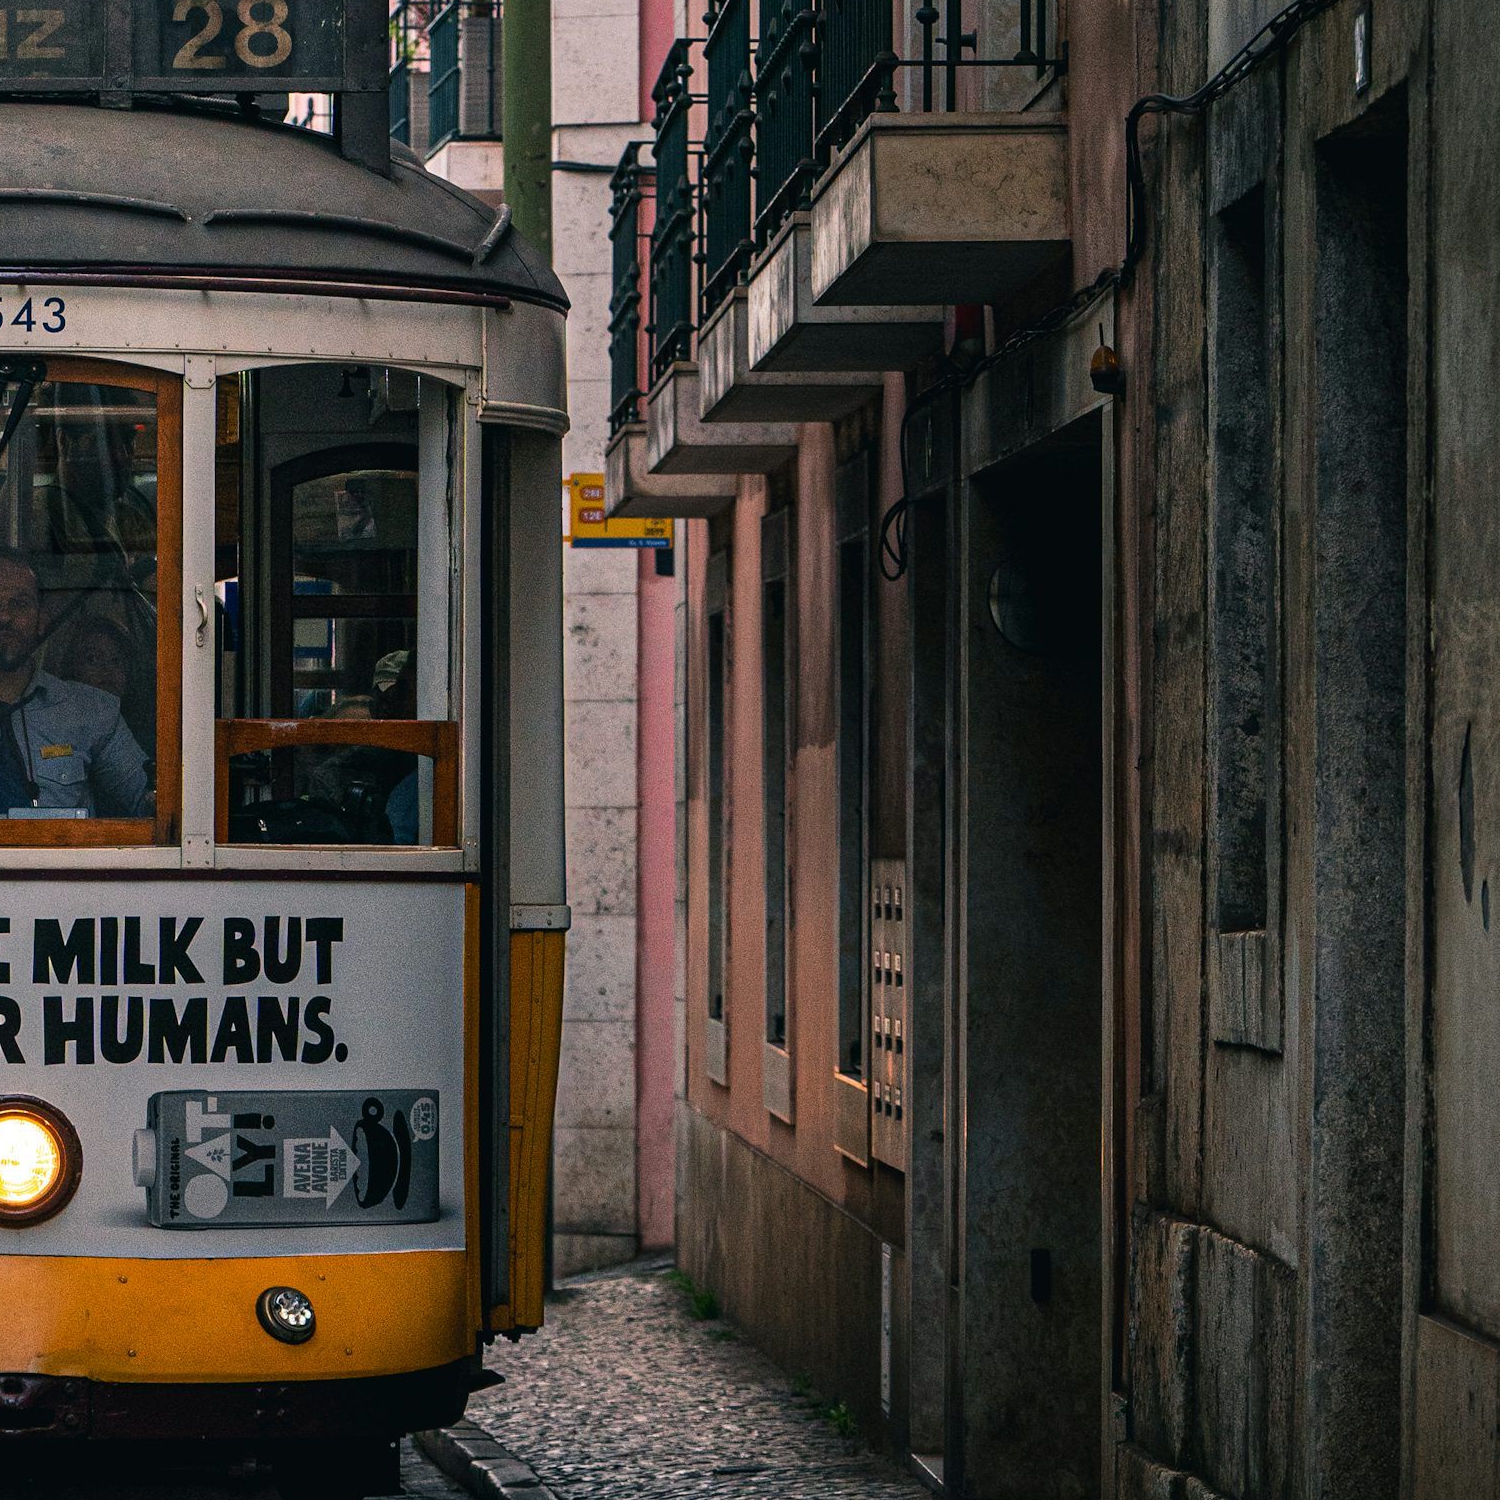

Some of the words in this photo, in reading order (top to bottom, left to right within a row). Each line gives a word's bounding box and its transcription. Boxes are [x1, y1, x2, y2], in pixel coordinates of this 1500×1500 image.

[32, 915, 206, 985] MILK
[222, 915, 344, 985] BUT
[43, 994, 349, 1066] HUMANS.
[169, 1137, 181, 1191] ORIGINAL
[232, 1112, 276, 1197] LY!
[293, 1142, 312, 1194] AVENA
[310, 1140, 328, 1194] AVOINE
[329, 1146, 340, 1182] BARISTA
[338, 1148, 348, 1181] EDITION
[169, 1193, 180, 1220] THE
